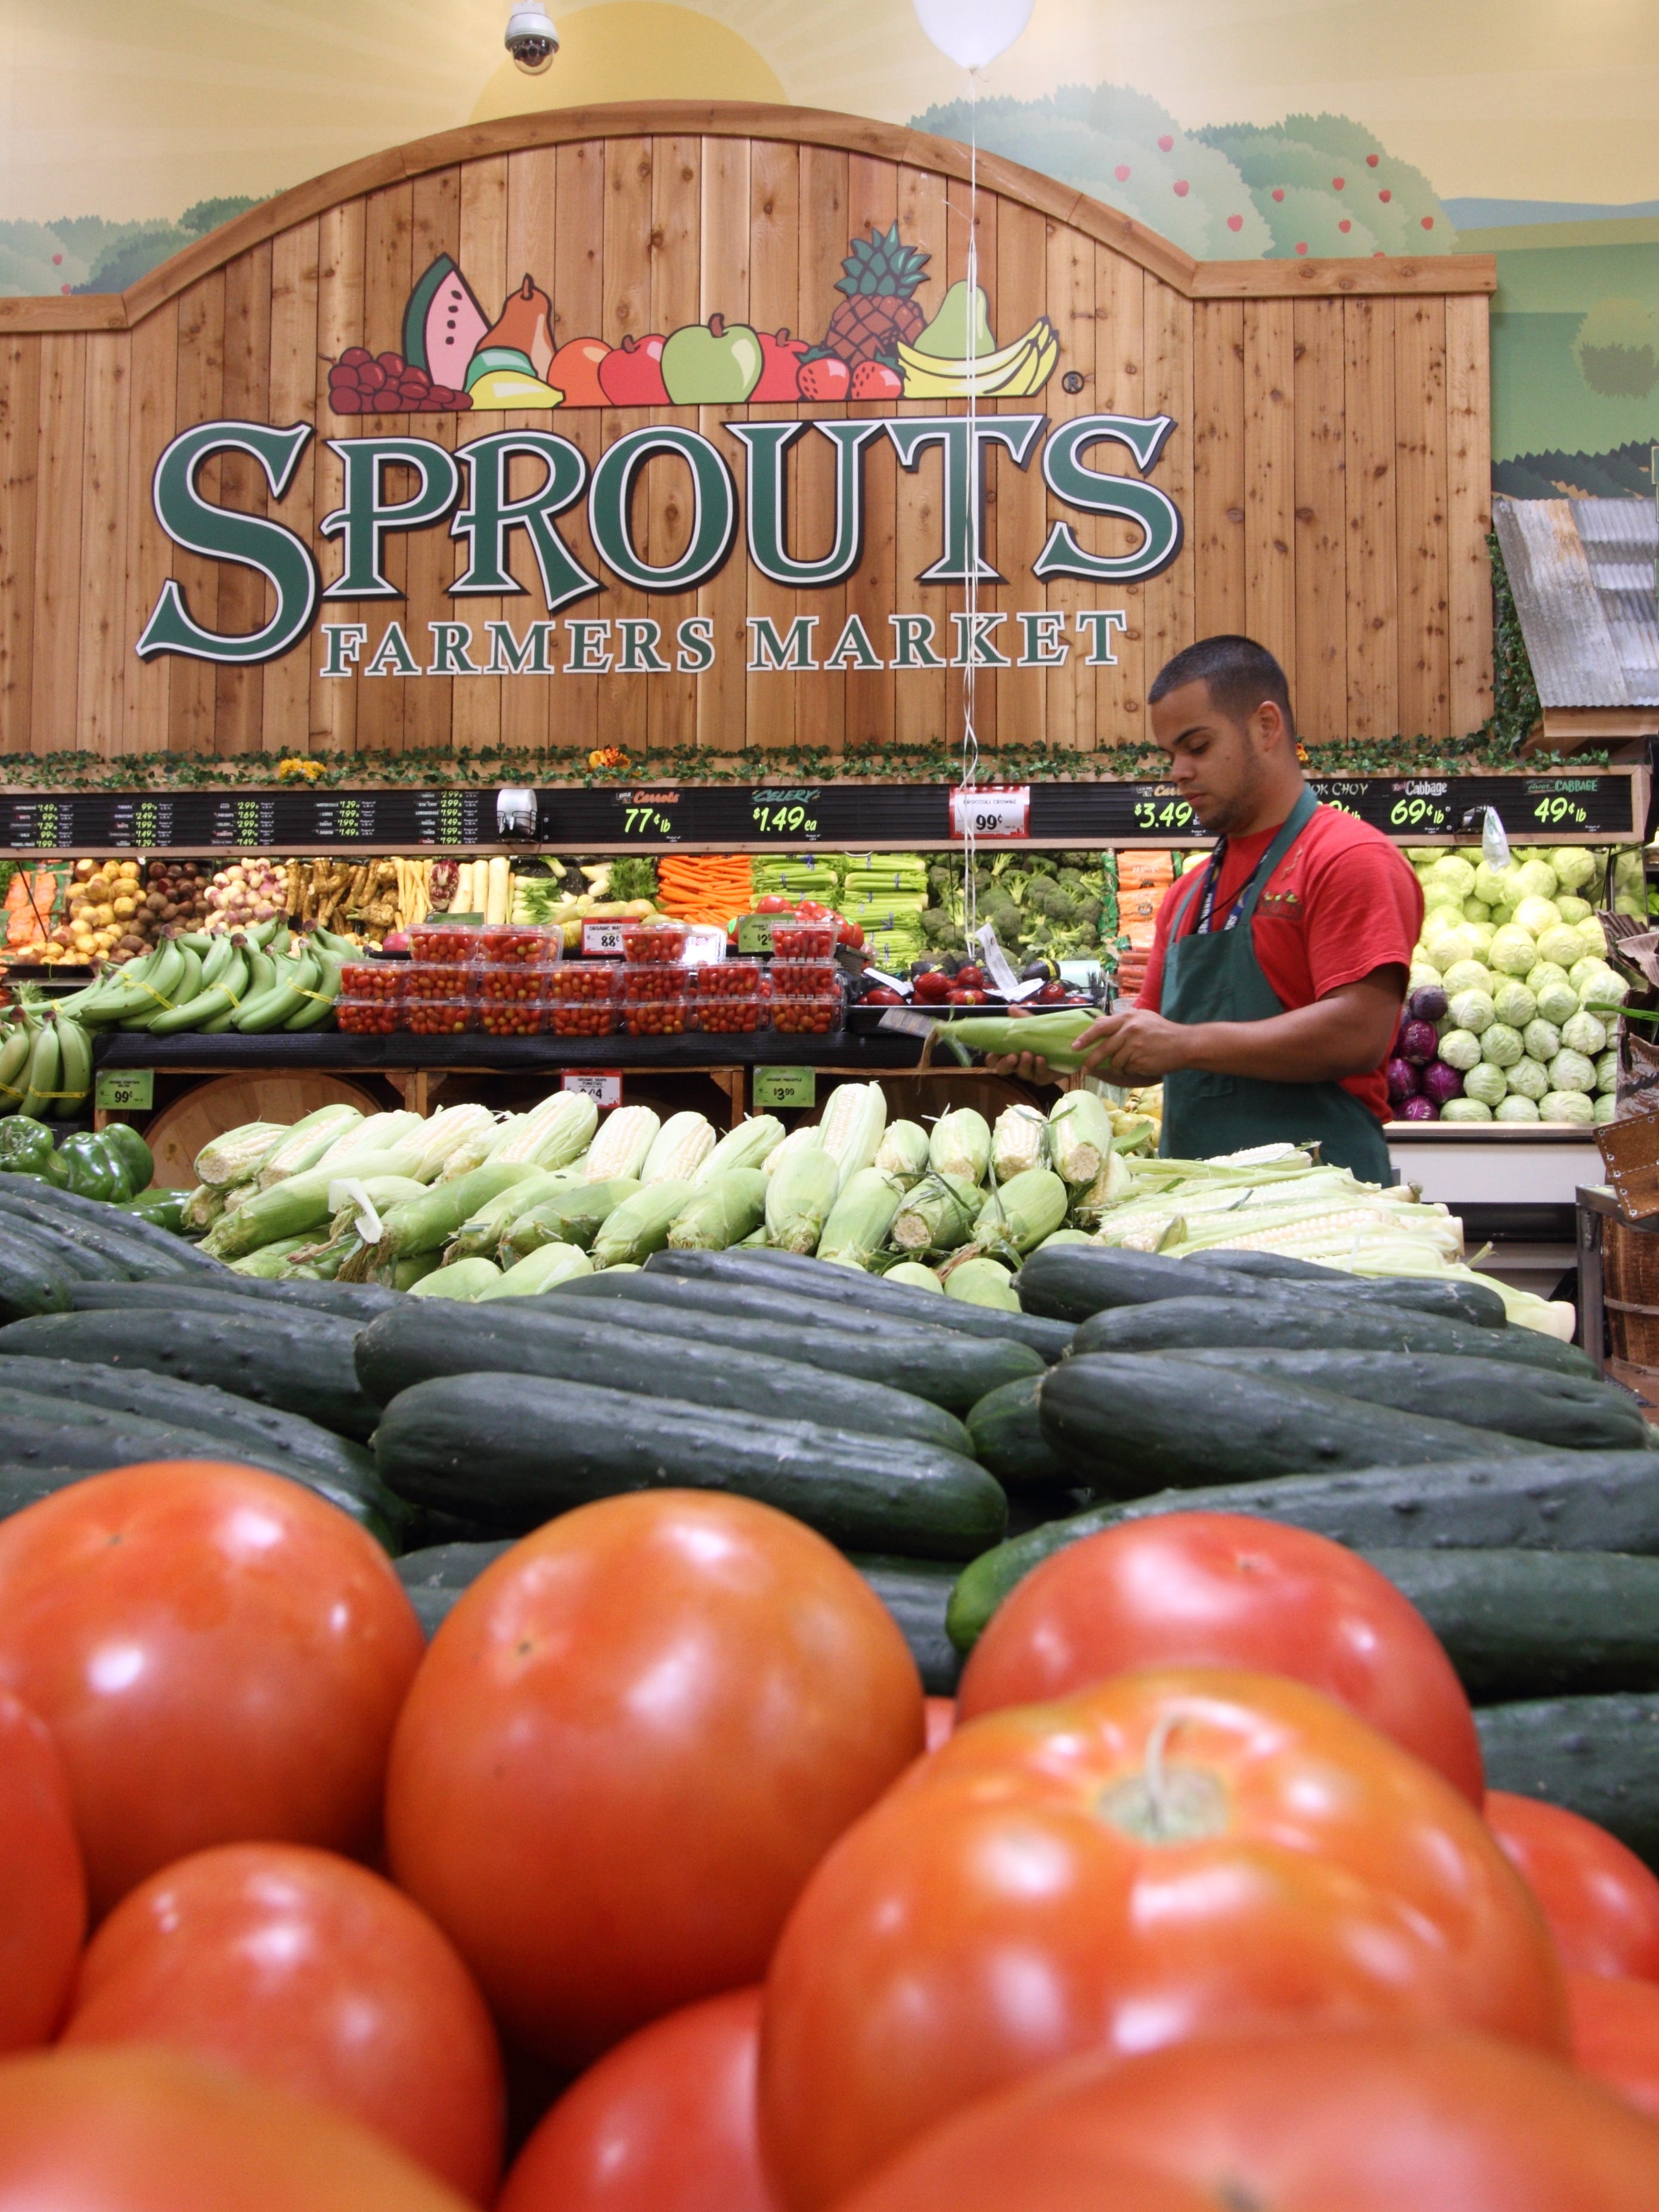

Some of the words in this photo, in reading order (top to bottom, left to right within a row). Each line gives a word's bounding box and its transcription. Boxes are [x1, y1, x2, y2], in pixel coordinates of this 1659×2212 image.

[135, 414, 1182, 663] SPROUTS
[320, 616, 715, 677] FARMERS
[746, 610, 1127, 671] MARKET
[1311, 783, 1329, 796] OK
[1332, 782, 1369, 796] CHOY
[1405, 780, 1447, 796] Cabbage
[1554, 779, 1598, 792] CABBAGE
[633, 790, 680, 804] Carrots
[753, 789, 819, 803] CELERY
[753, 806, 805, 832] $1.49
[804, 820, 817, 831] ea
[1134, 802, 1192, 828] $3.49
[1433, 809, 1444, 824] lb
[1576, 808, 1586, 822] lb
